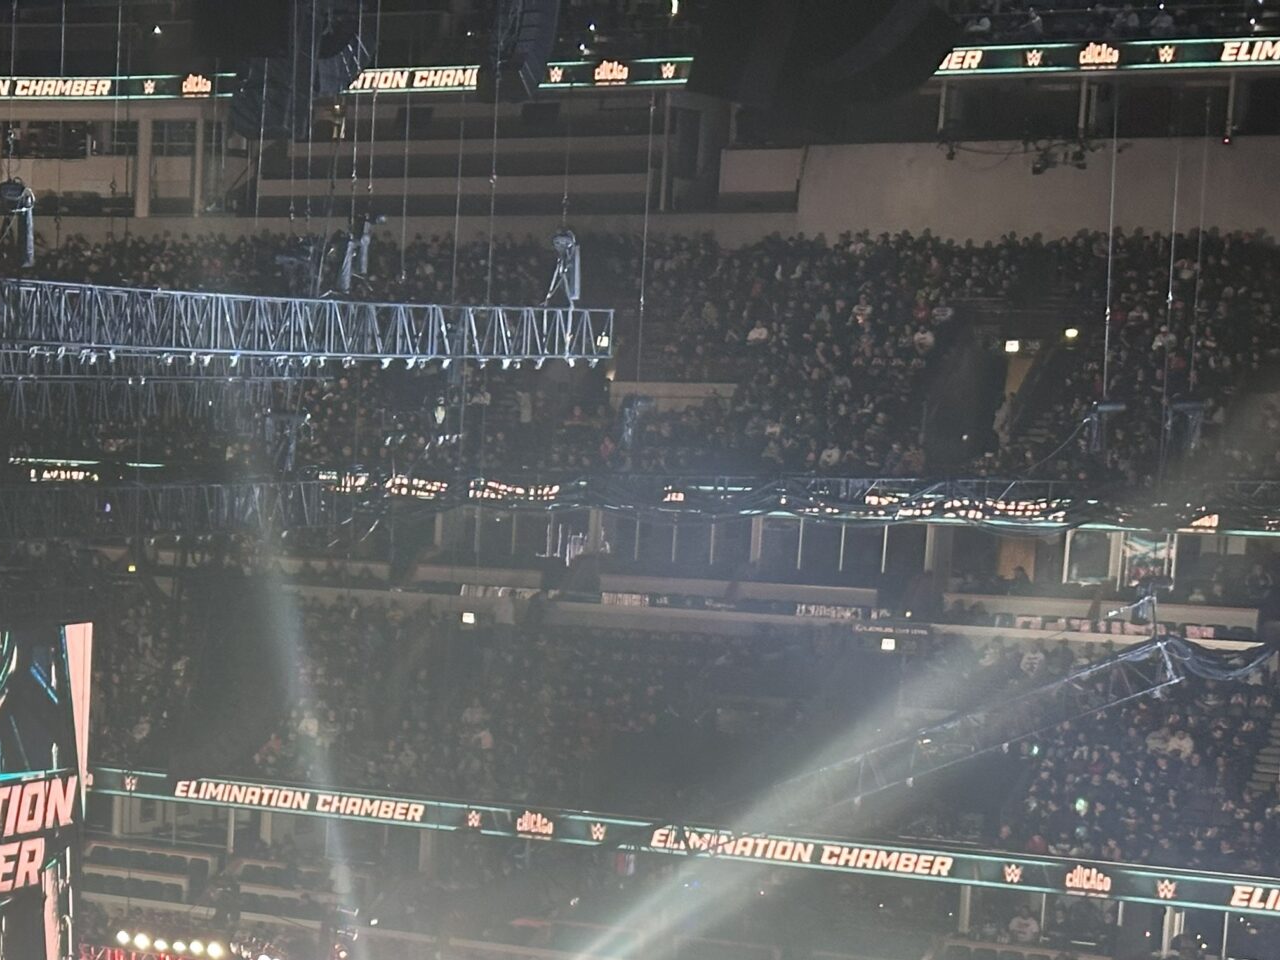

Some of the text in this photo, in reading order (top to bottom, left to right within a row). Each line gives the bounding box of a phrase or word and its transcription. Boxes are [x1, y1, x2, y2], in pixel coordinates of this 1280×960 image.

[13, 78, 112, 96] CHAMBER
[174, 780, 311, 811] ELIMINATION
[316, 794, 425, 823] CHAMBER
[516, 809, 553, 835] CHICAGO
[651, 826, 814, 863] ELIMINATION
[820, 844, 953, 877] CHAMBER
[1065, 863, 1112, 894] CHICAGO
